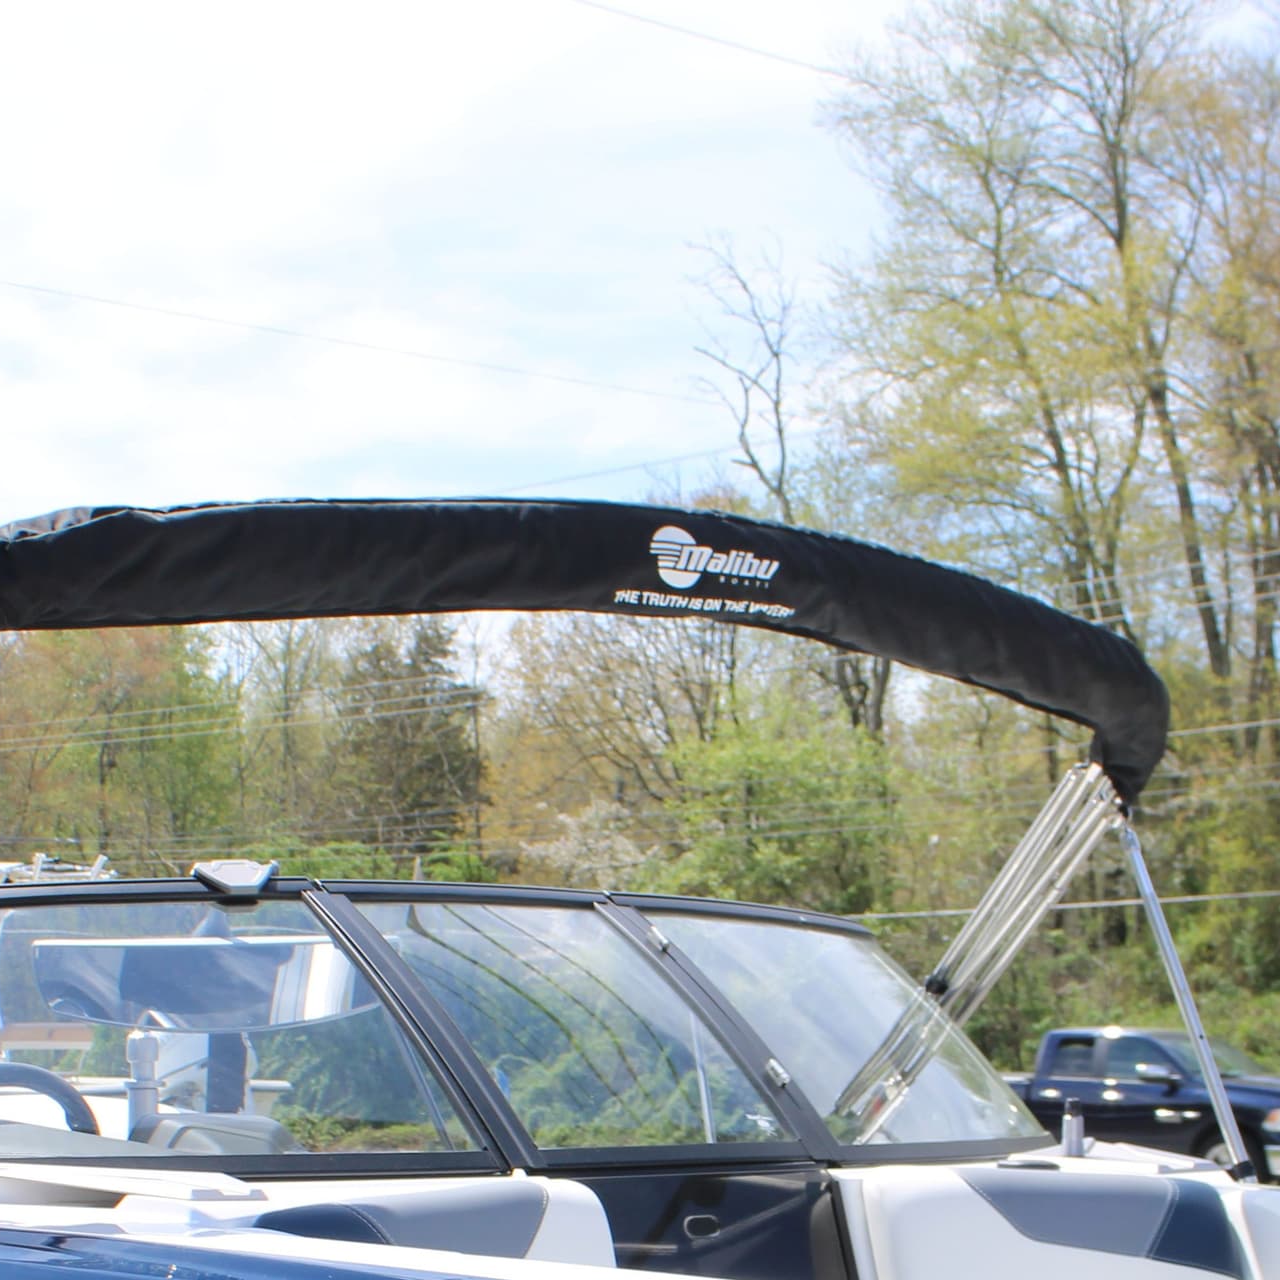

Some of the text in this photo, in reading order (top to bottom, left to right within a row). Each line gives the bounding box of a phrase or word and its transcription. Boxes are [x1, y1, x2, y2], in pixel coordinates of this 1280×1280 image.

[676, 545, 780, 580] Malibu
[614, 590, 640, 605] THE
[641, 591, 689, 608] TRUTH
[688, 596, 705, 611] IS
[703, 598, 723, 611] ON
[724, 599, 749, 613] THE
